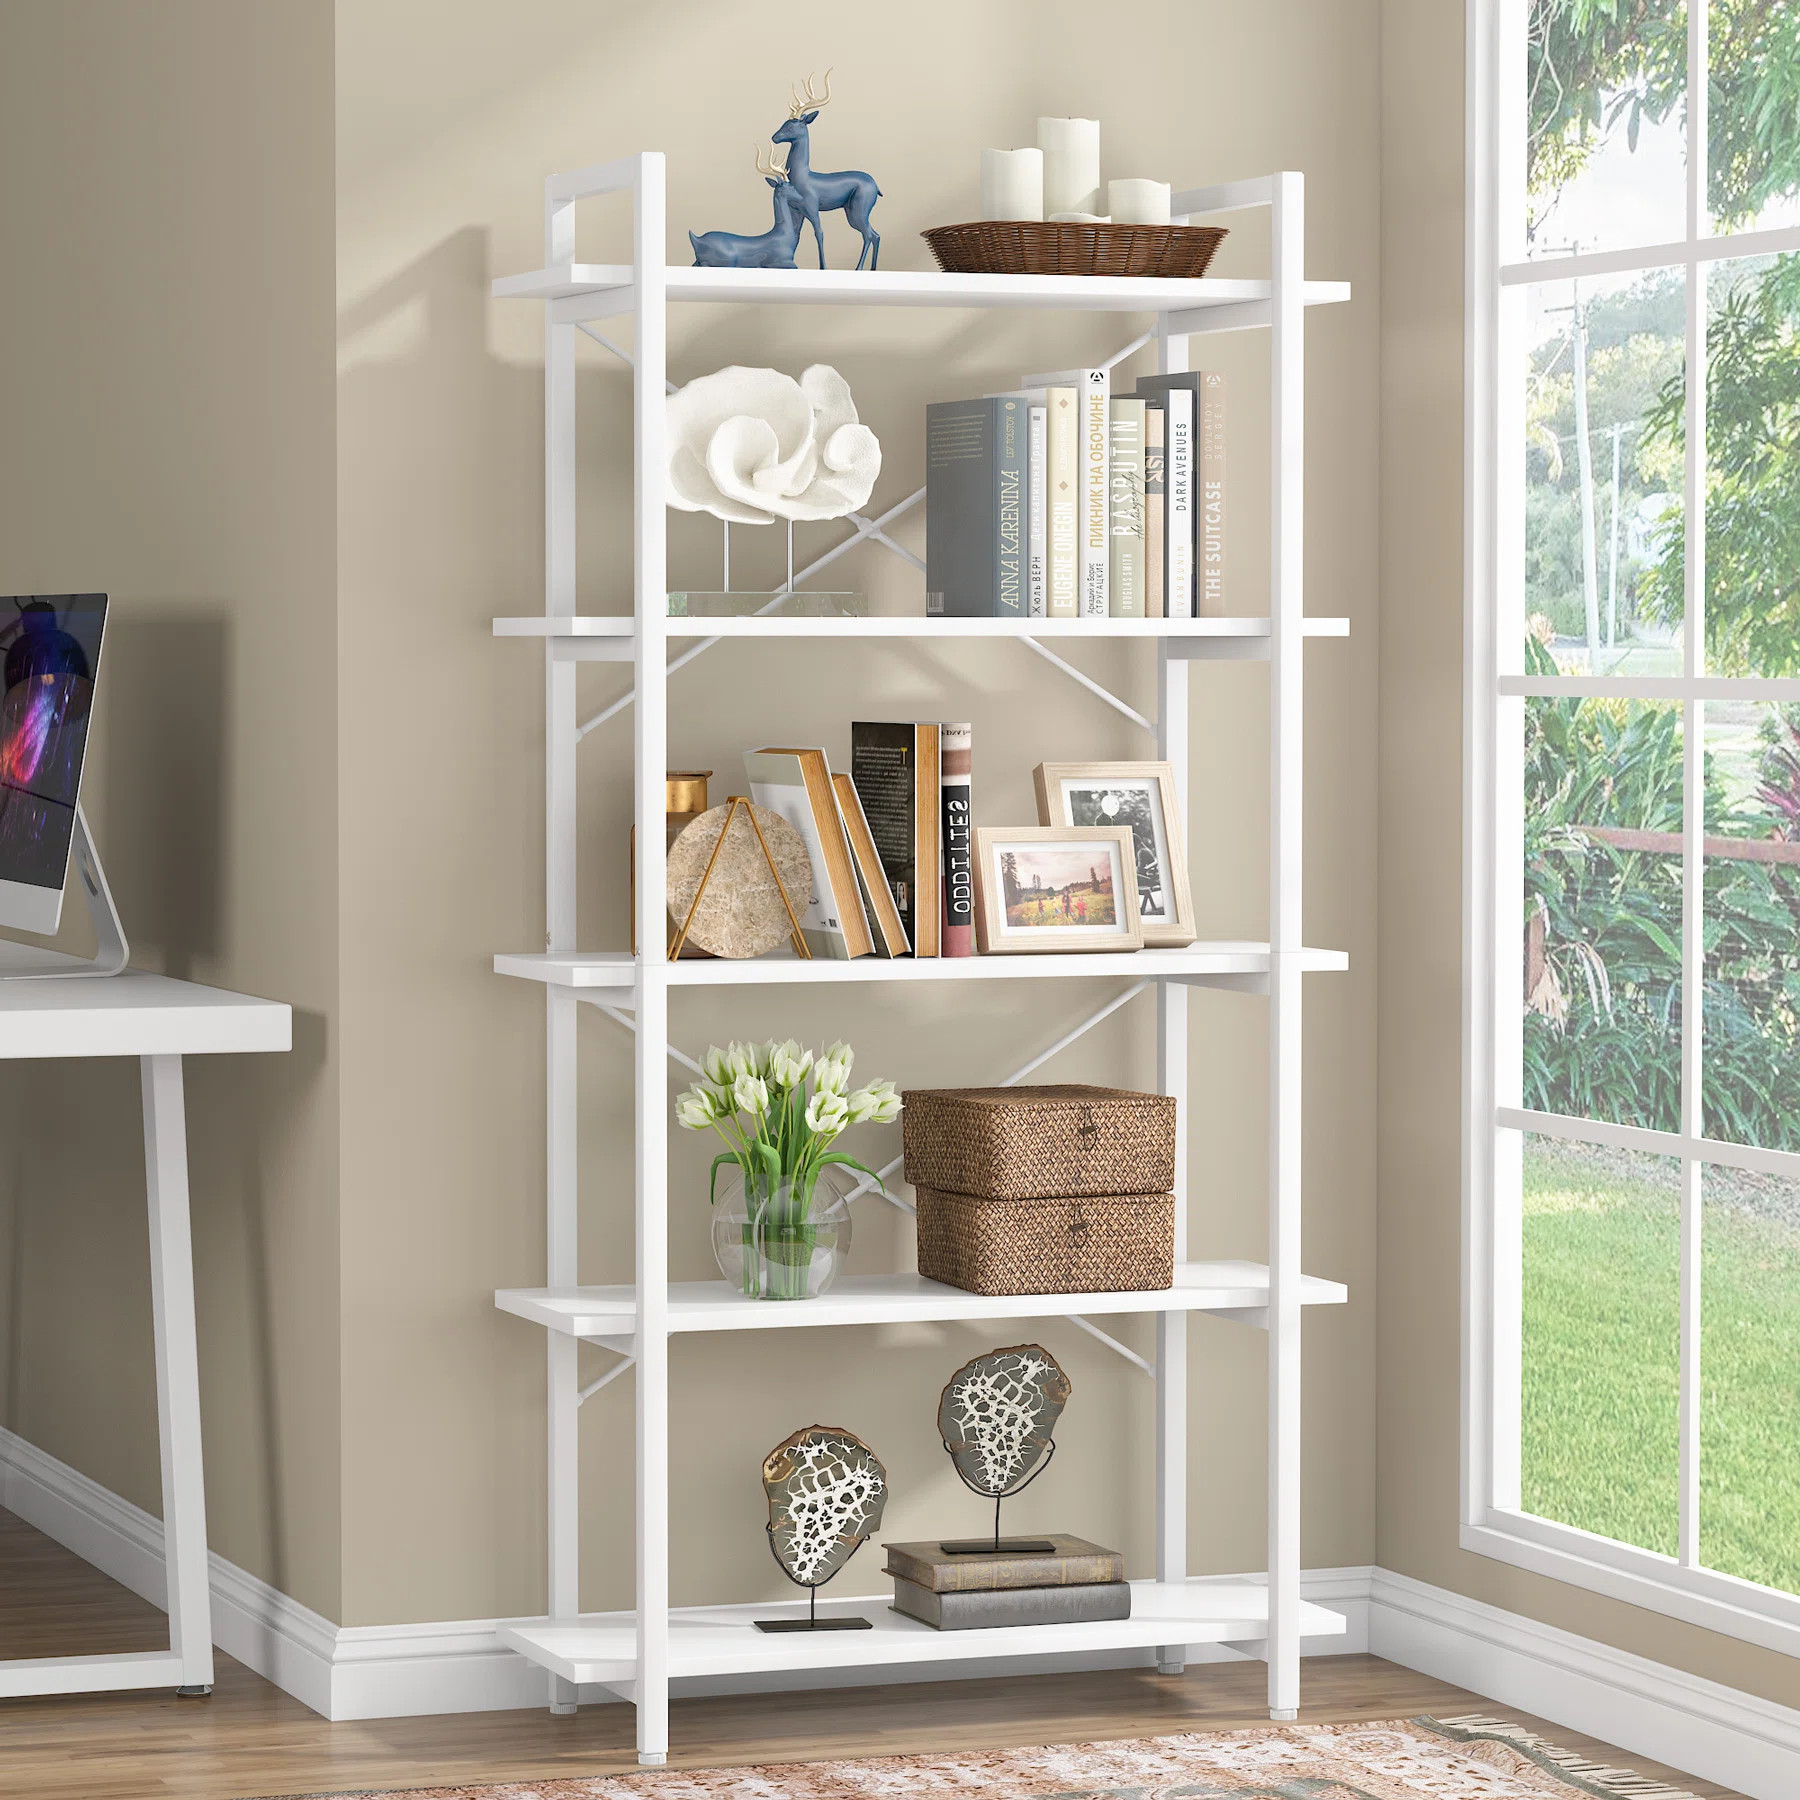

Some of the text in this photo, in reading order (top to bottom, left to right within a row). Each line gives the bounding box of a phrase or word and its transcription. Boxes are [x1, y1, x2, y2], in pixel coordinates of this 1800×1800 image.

[1006, 415, 1016, 458] LEV TOLSTOY
[1089, 394, 1104, 461] ОБОЧИНЕ
[1204, 402, 1213, 460] DOVLATOV
[1214, 402, 1223, 460] SERGEY
[1031, 427, 1041, 541] Дети капитана Гранта
[1089, 465, 1104, 485] НА
[1112, 420, 1139, 536] RASPUTIN
[1176, 423, 1187, 511] DARK AVENUES
[1089, 489, 1104, 548] ПИКНИК
[1122, 470, 1144, 540] the biography
[1001, 469, 1019, 609] ANNA KARENINA
[1054, 502, 1073, 608] EUGENE ONEGIN
[1205, 481, 1221, 600] THE SUITCASE
[1031, 556, 1041, 614] Жюль ВЕРН
[1087, 562, 1095, 581] Борис
[1087, 588, 1096, 614] Аркадий
[1095, 562, 1104, 614] СТРУГАЦКИЕ
[1122, 553, 1133, 610] DOUGLAS SMITH
[1176, 545, 1185, 612] IVAN BUNIN
